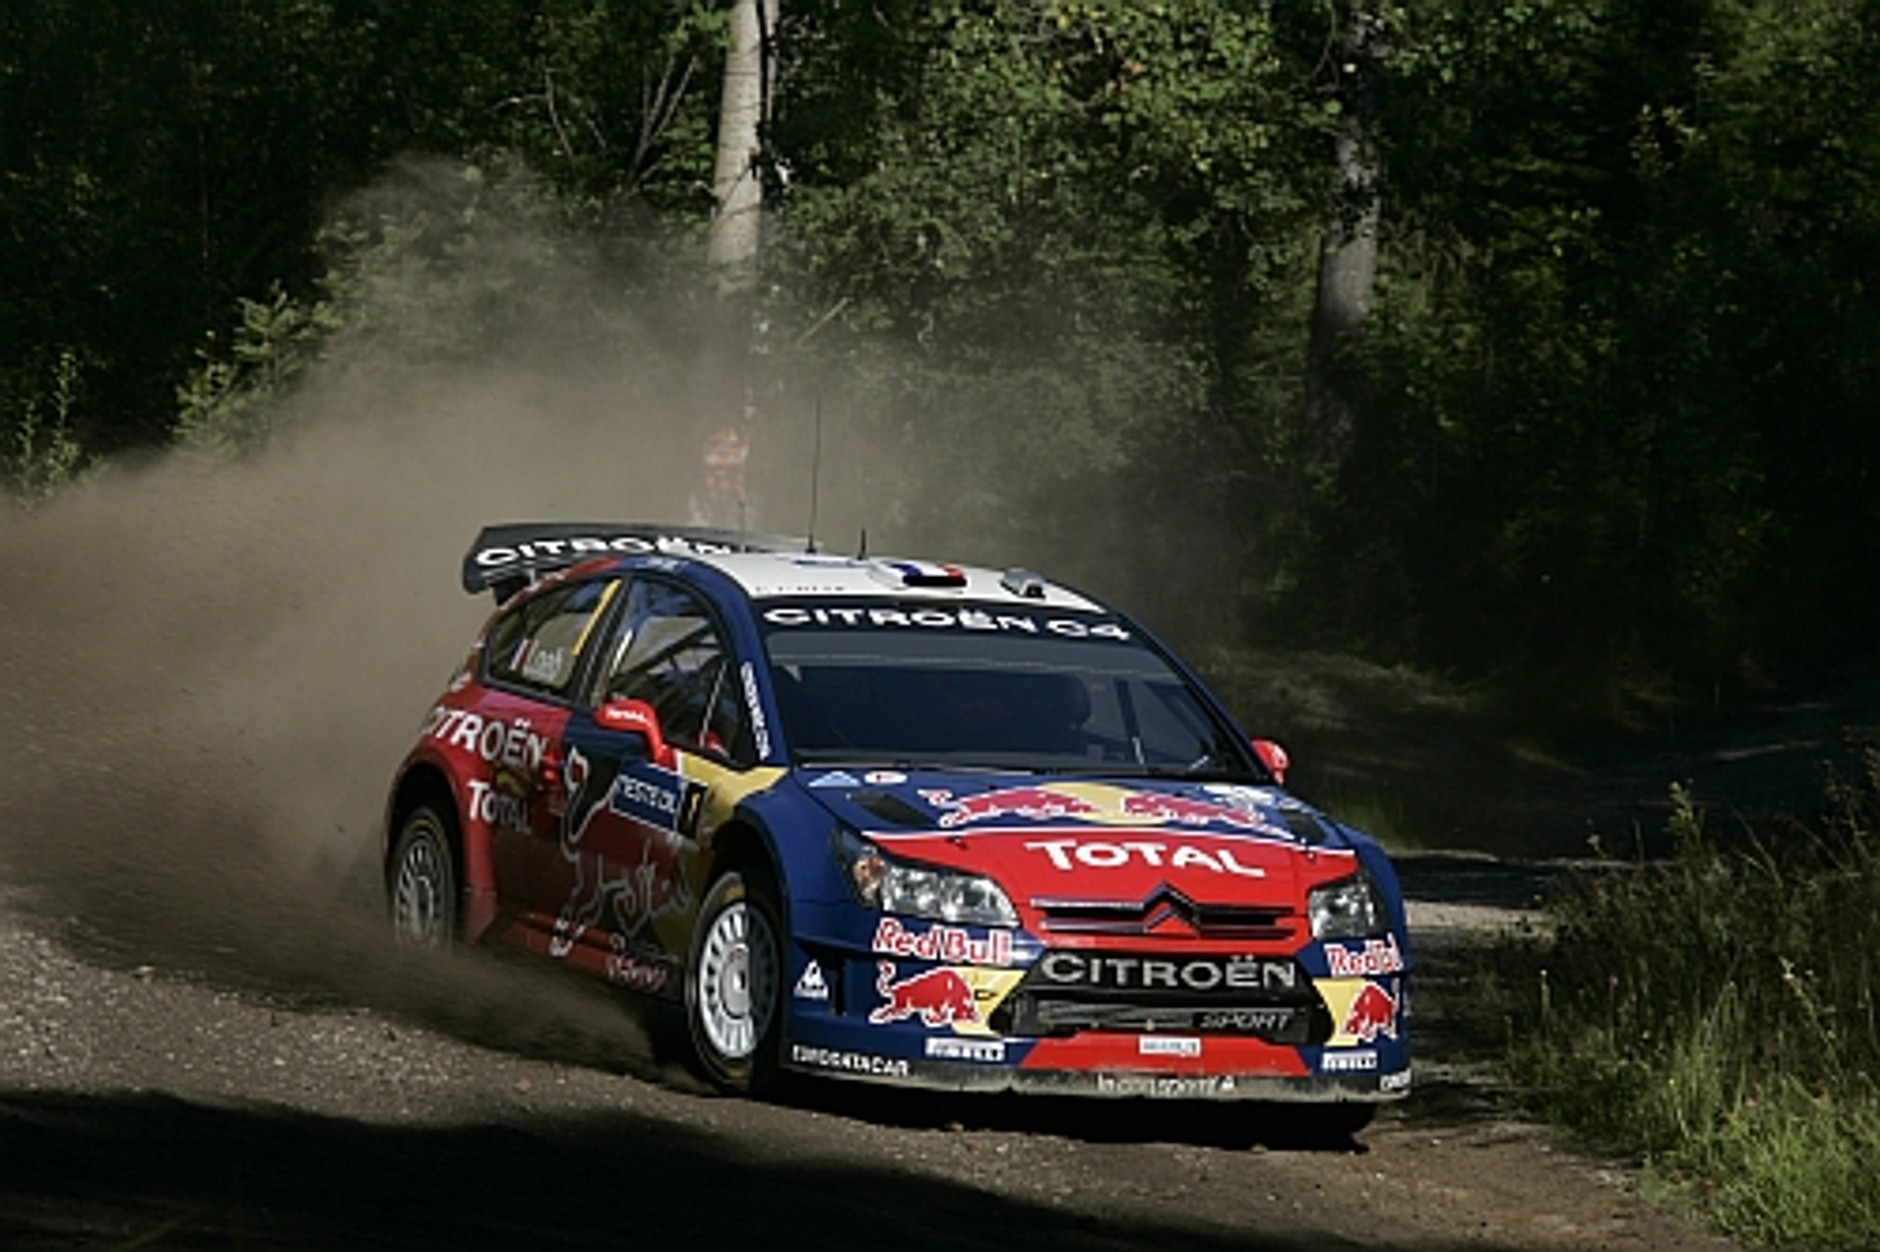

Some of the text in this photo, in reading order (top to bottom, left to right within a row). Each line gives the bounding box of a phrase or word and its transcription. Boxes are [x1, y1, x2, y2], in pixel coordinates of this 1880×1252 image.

[763, 606, 1132, 641] CITROËN C4
[466, 778, 532, 837] TOTAL
[1024, 839, 1266, 878] TOTAL
[872, 917, 1012, 967] Red Bull
[1041, 952, 1296, 989] CITROËN
